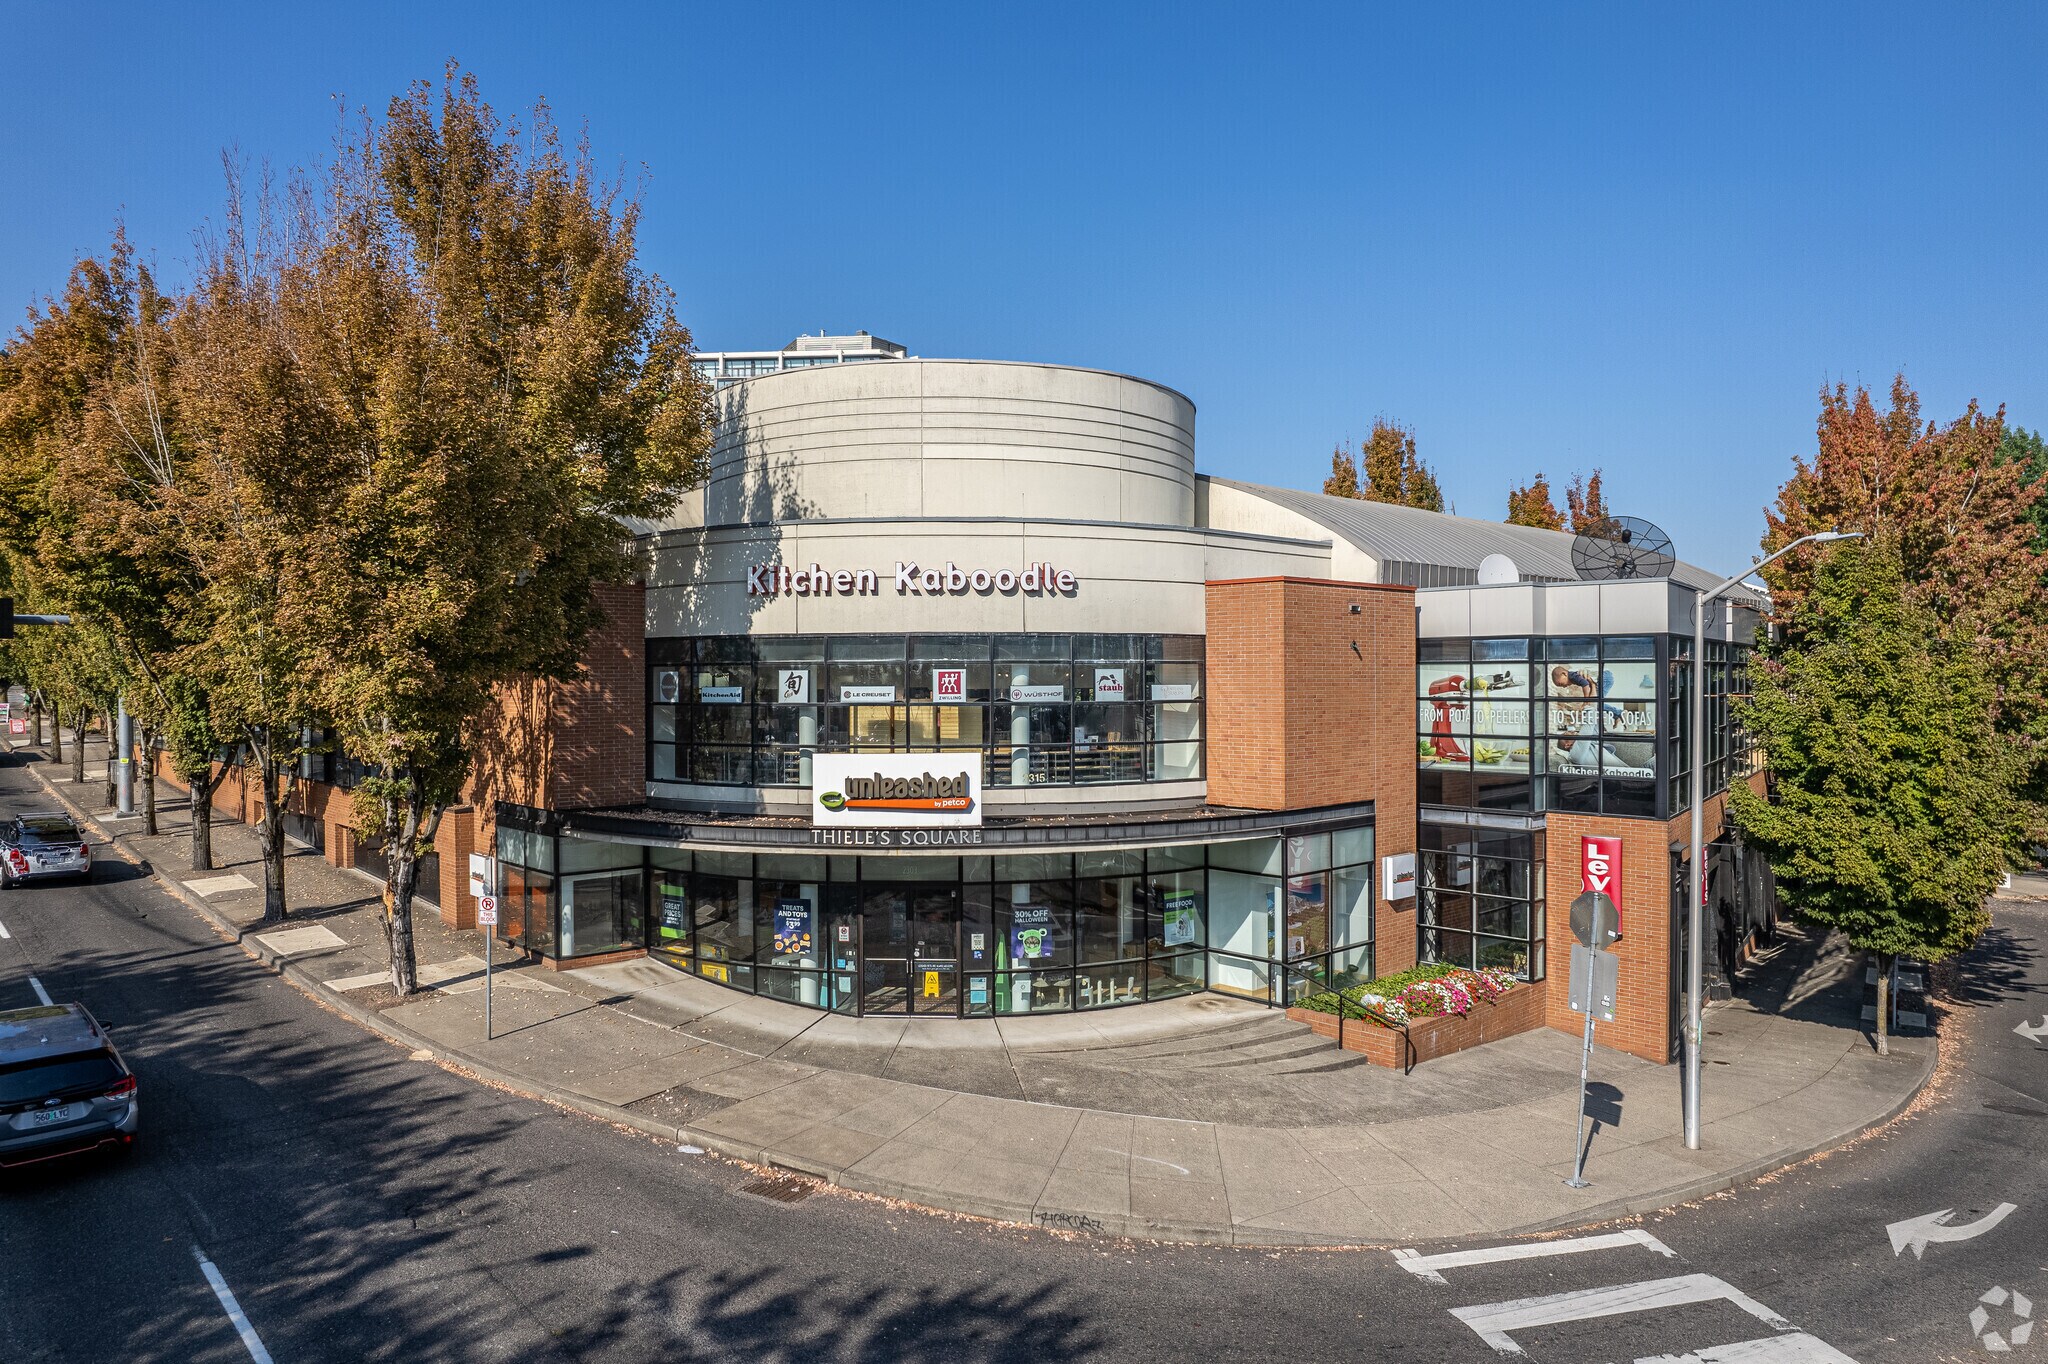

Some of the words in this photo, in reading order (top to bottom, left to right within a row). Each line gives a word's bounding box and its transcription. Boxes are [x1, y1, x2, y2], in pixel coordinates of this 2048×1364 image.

[747, 563, 876, 595] Kitchen
[895, 561, 1077, 594] Kaboodle
[784, 671, 803, 695] 旬
[1098, 683, 1123, 692] staub
[1420, 707, 1443, 722] FROM
[1449, 707, 1483, 724] POTATO
[1491, 710, 1530, 724] PEELERS
[1552, 710, 1565, 724] TO
[1570, 710, 1614, 726] SLEEPER
[1620, 711, 1652, 726] SOFAS
[1562, 765, 1598, 775] Kitchen
[1603, 769, 1652, 777] Kaboodle
[844, 771, 967, 798] unleashed
[942, 799, 966, 807] petco
[811, 829, 891, 845] THIELE'S
[901, 829, 982, 845] SQUARE
[664, 902, 681, 910] GREAT
[1179, 899, 1192, 907] FOOD
[664, 909, 681, 917] PRICES
